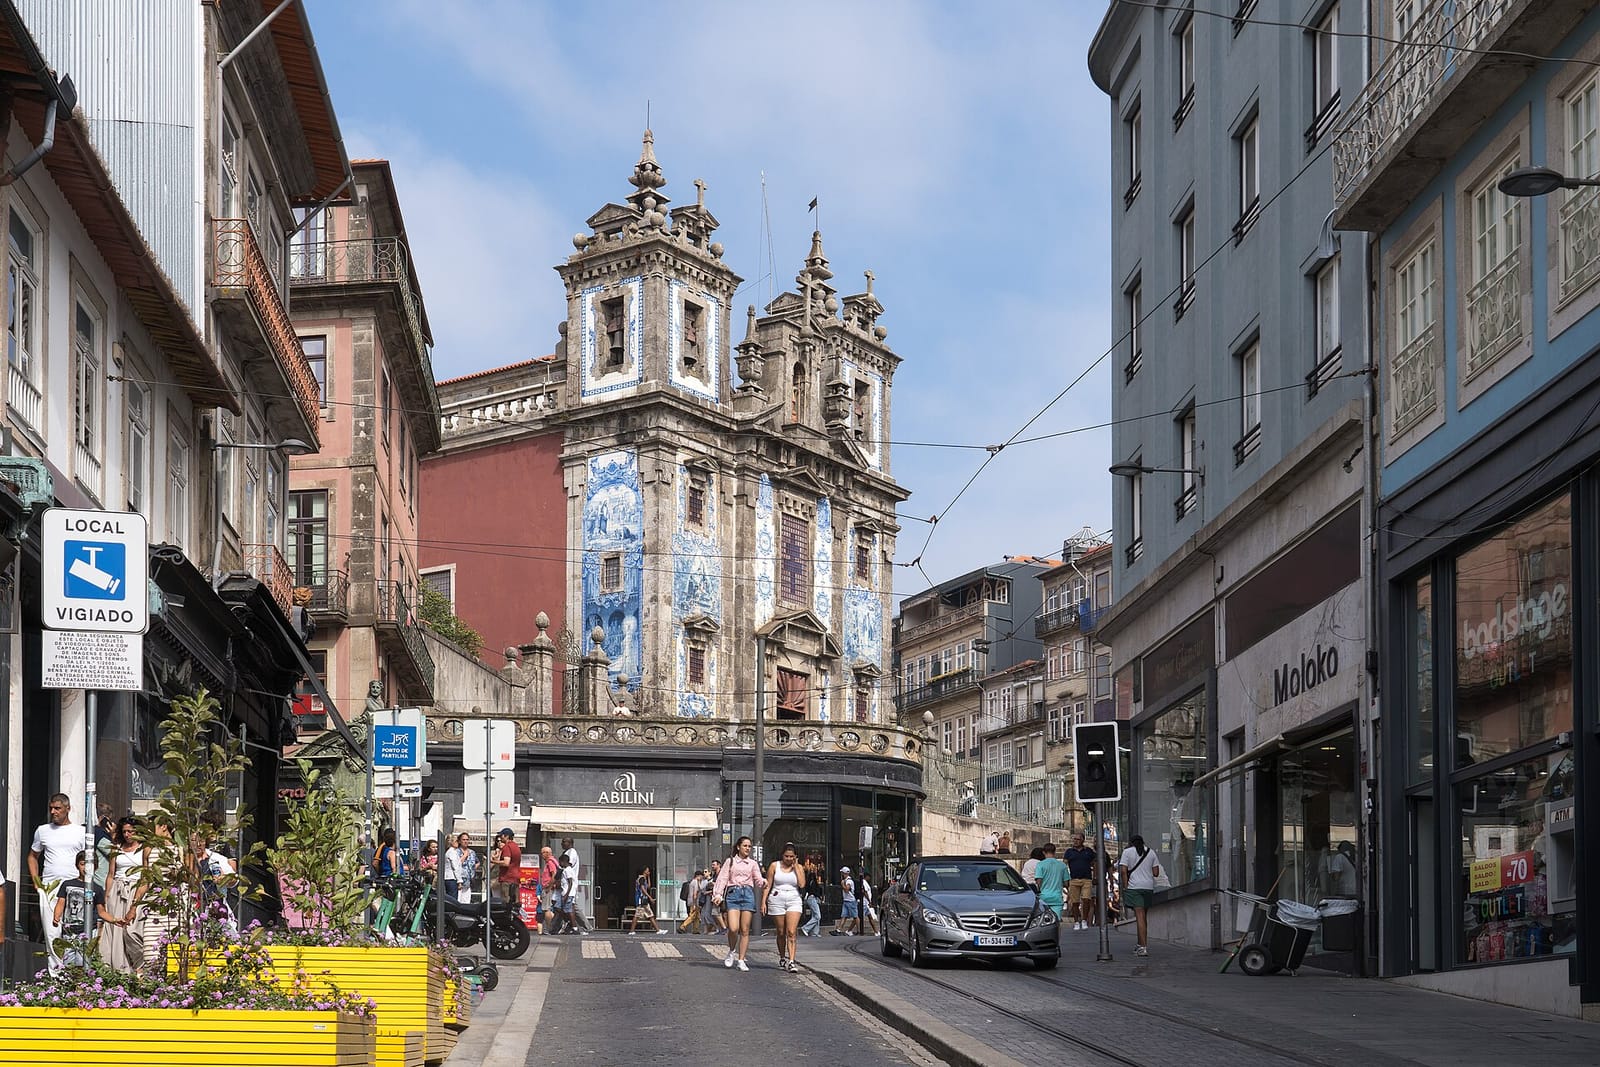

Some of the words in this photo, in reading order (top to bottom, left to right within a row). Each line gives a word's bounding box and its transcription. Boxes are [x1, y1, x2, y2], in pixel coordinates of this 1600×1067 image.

[65, 518, 125, 535] LOCAL
[56, 607, 134, 624] VIGIADO
[1273, 645, 1339, 707] Moloko
[598, 792, 654, 805] ABILINI
[1554, 808, 1570, 823] ATM
[1474, 862, 1496, 871] SALDOS
[1481, 894, 1522, 919] OUTLET
